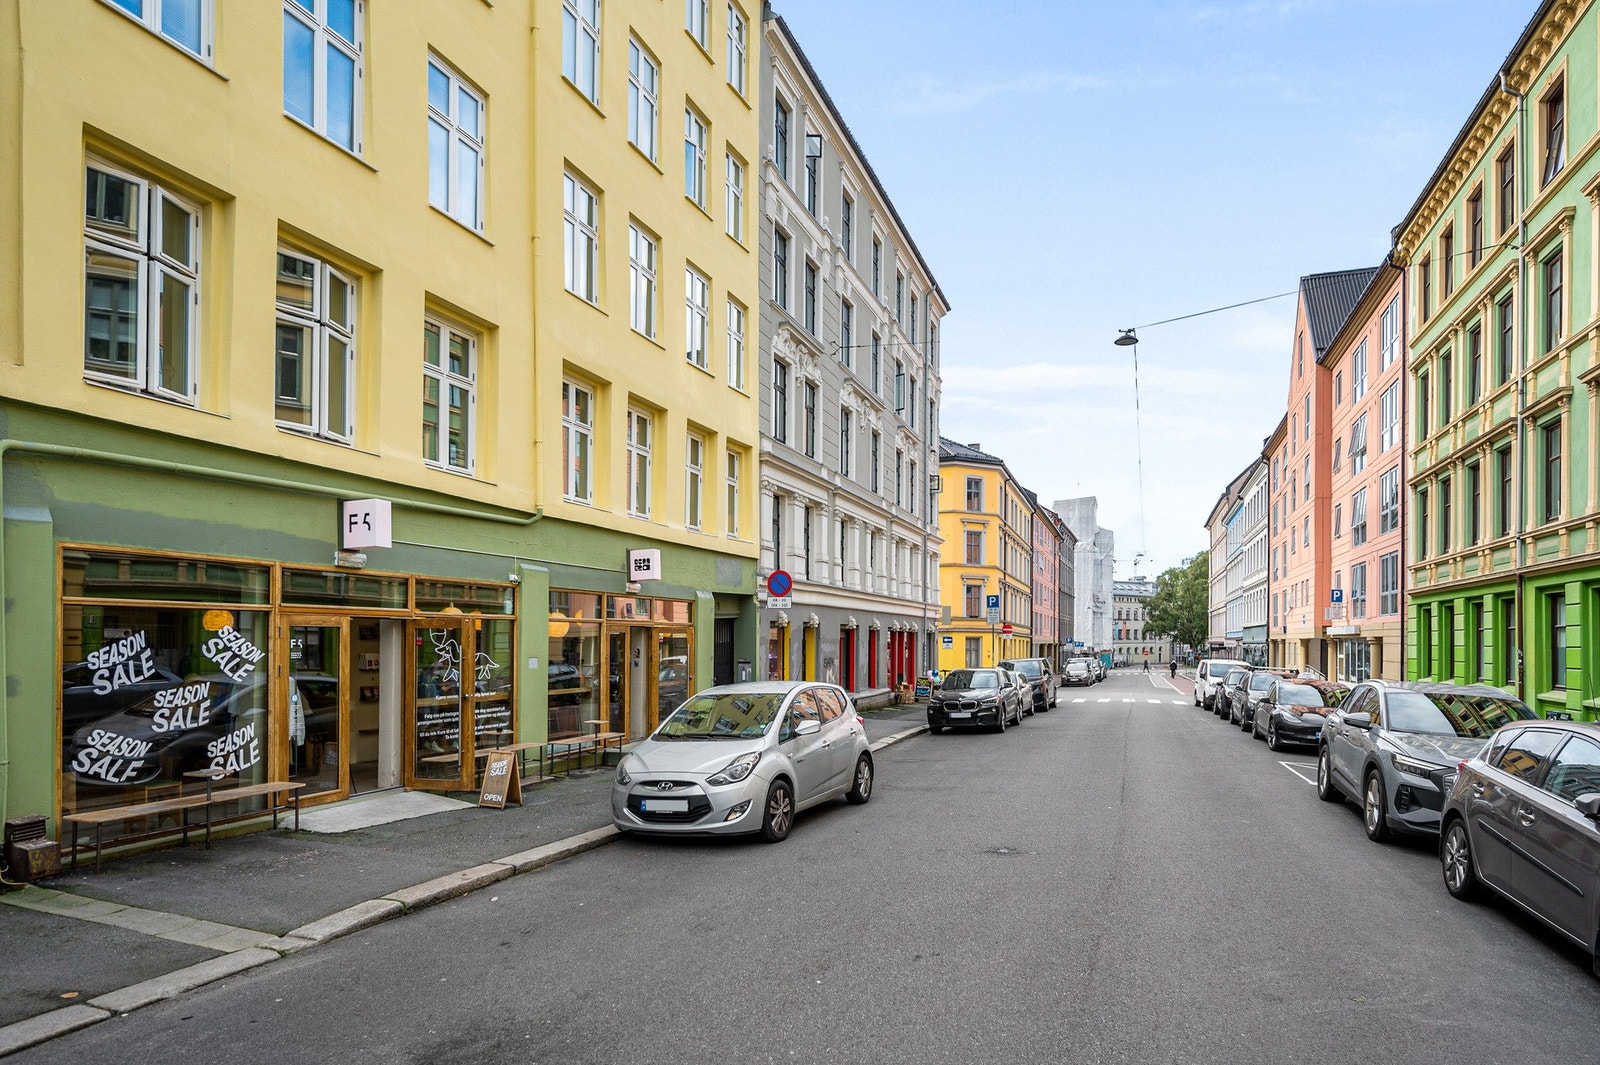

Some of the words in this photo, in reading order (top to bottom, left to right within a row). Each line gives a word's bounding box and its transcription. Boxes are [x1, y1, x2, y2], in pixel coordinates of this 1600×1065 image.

[87, 630, 146, 670] SEASON
[201, 638, 256, 682] SALE
[218, 624, 266, 664] SEASON
[92, 648, 156, 695] SALE
[154, 682, 210, 708] SEASON
[152, 699, 211, 733] SALE
[87, 729, 152, 758] SEASON
[207, 722, 255, 758] SEASON
[210, 738, 261, 780] SALE
[490, 766, 508, 776] SALE
[483, 793, 503, 802] OPEN
